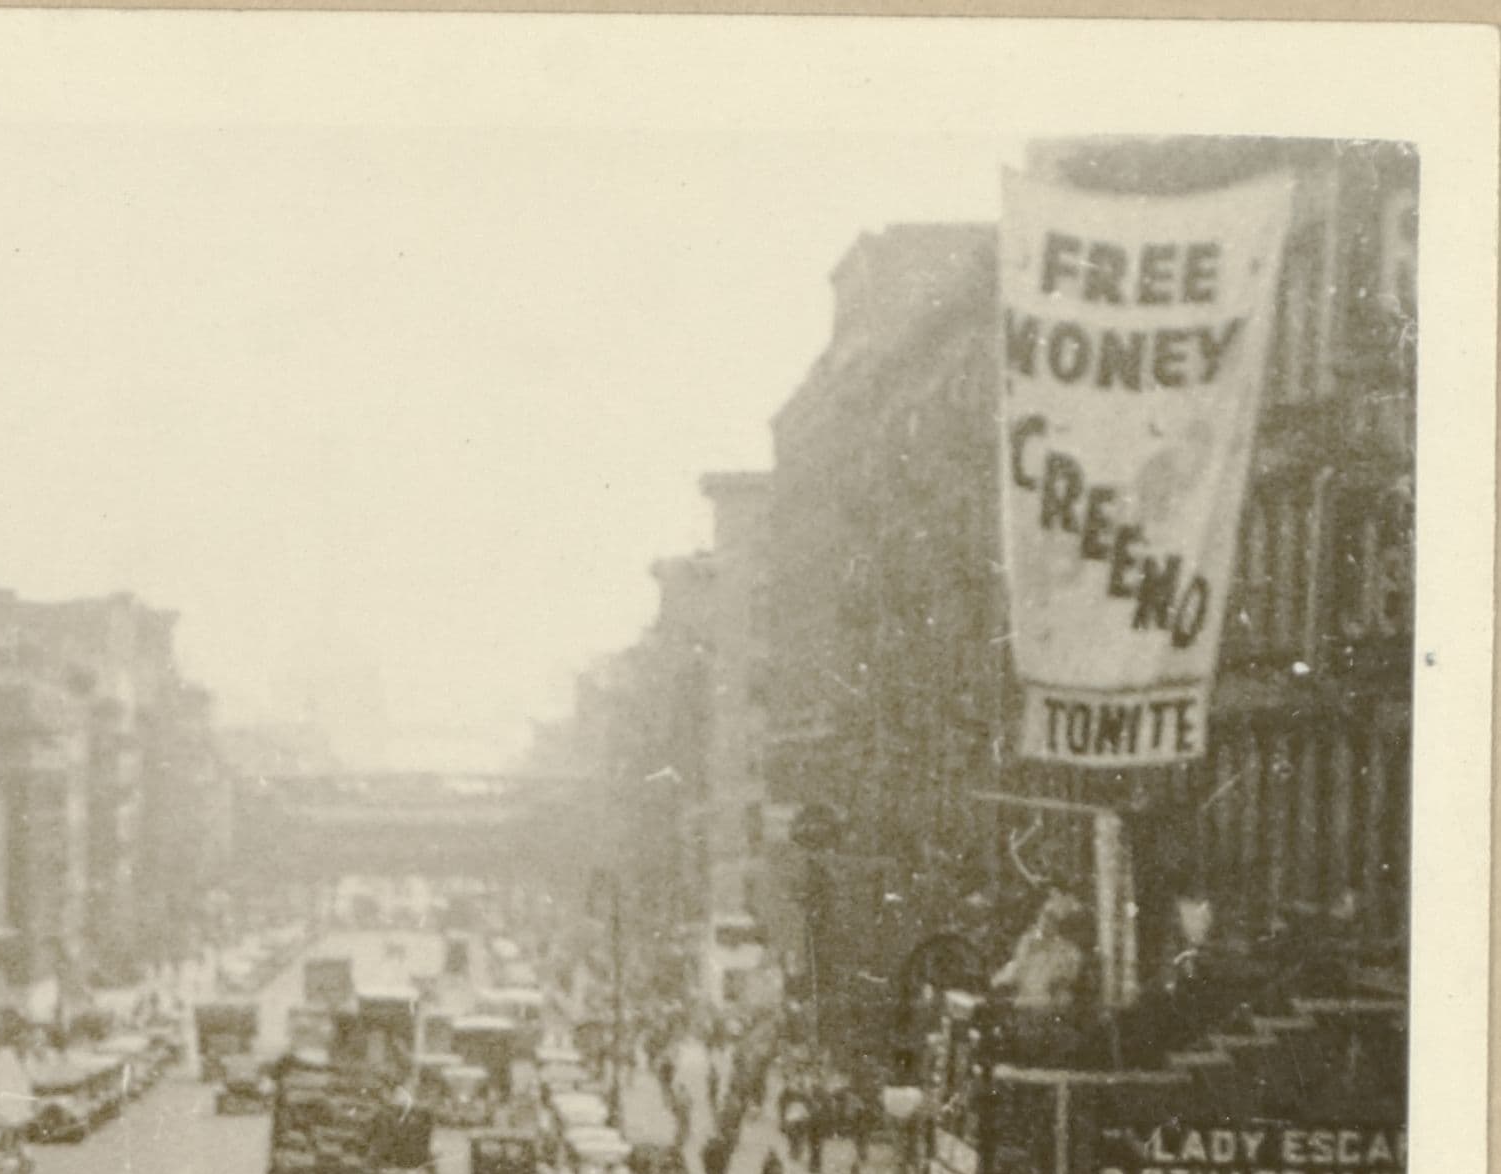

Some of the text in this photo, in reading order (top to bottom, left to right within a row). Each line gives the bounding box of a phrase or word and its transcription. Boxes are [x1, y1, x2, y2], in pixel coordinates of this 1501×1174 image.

[1041, 232, 1223, 306] FREE
[1004, 310, 1246, 392] MONEY
[1045, 697, 1197, 755] TONITE
[1151, 1127, 1266, 1163] LADY
